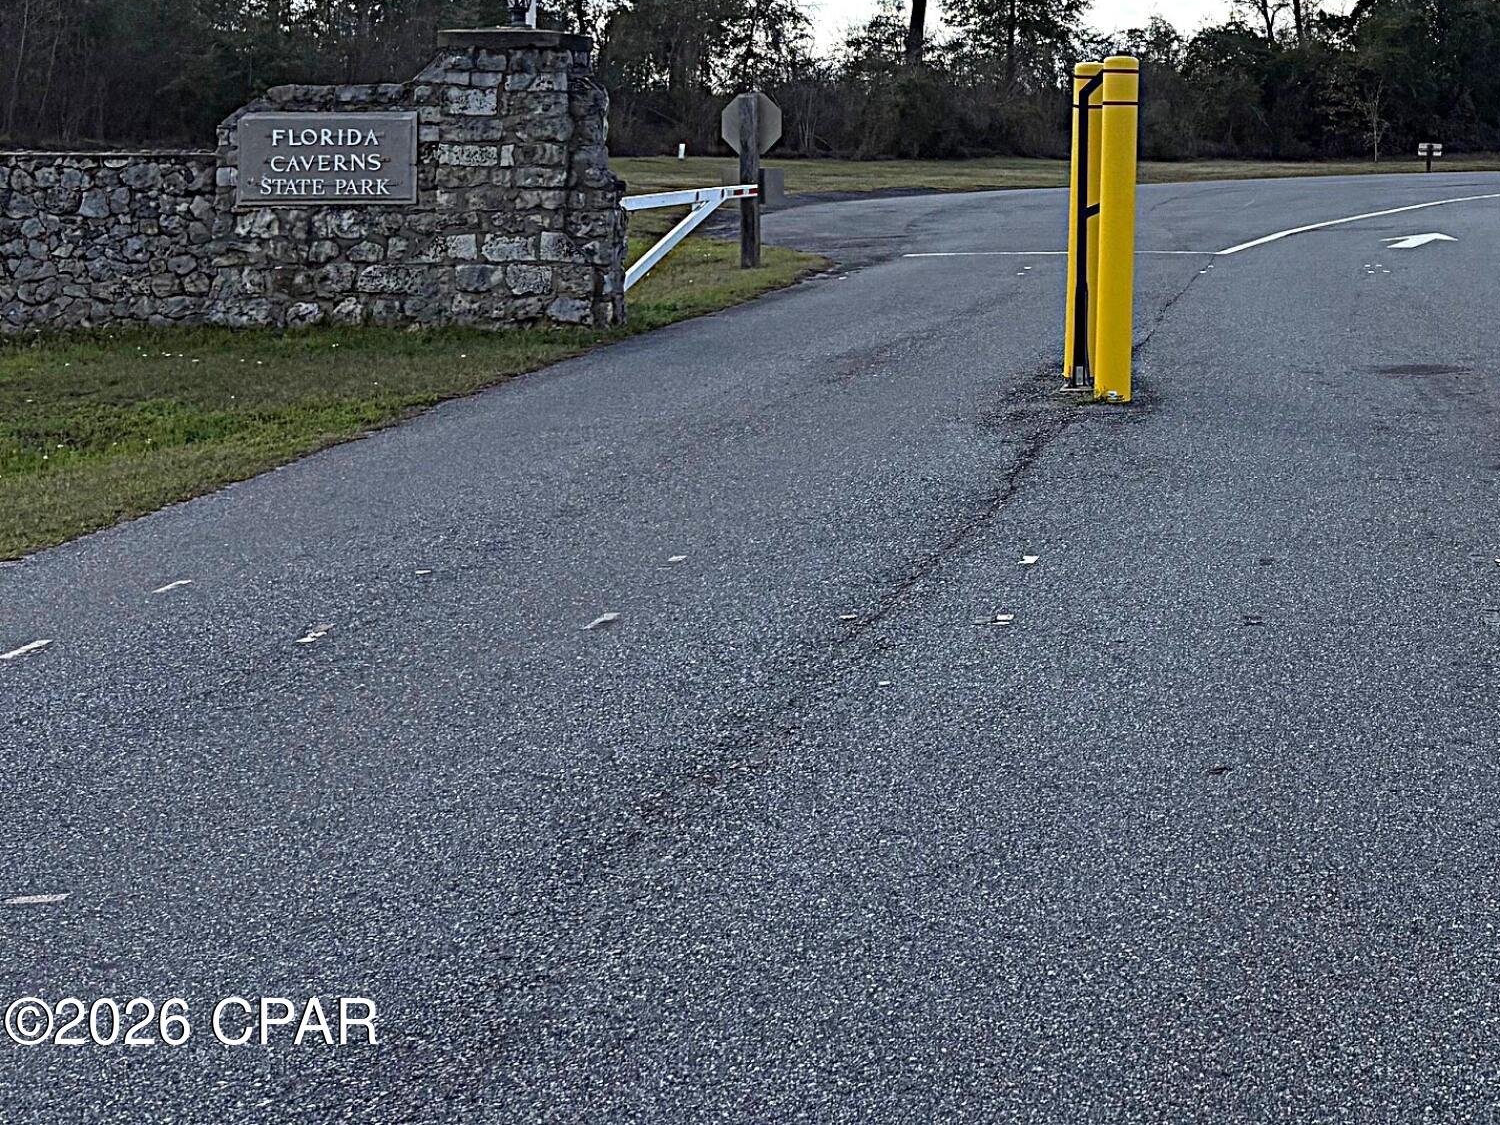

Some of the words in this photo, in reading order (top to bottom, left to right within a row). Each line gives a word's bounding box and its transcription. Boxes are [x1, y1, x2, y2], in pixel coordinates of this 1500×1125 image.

[271, 128, 380, 147] FLORIDA
[270, 153, 382, 172] CAVERNS
[259, 178, 326, 195] STATE
[335, 178, 391, 195] PARK
